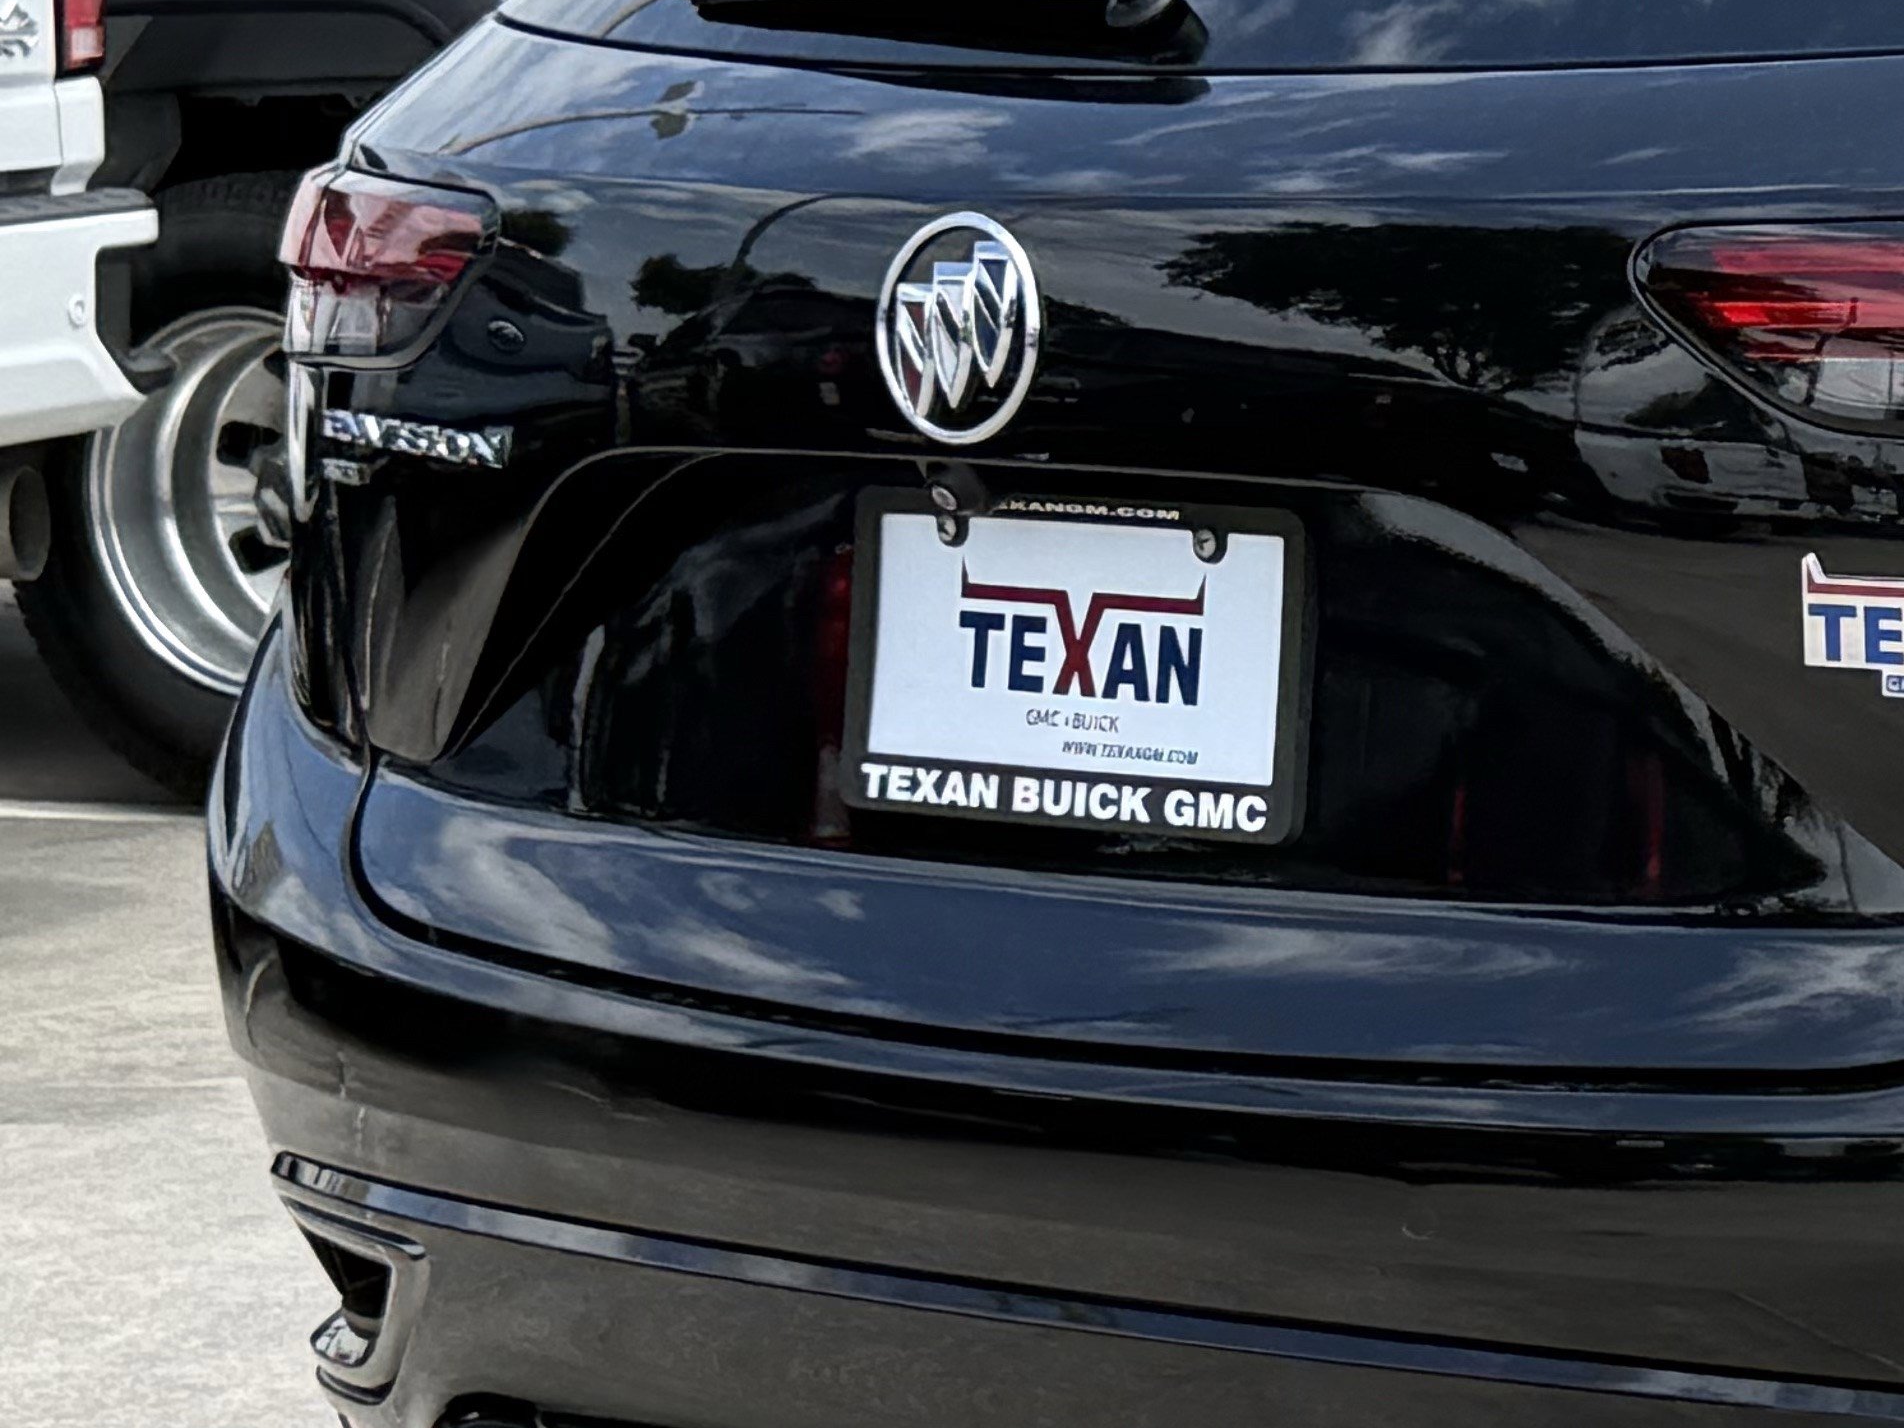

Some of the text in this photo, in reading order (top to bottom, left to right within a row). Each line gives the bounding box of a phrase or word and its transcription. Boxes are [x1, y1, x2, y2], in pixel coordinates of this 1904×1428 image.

[959, 591, 1203, 706] TEXAN
[1072, 712, 1119, 733] BUICK
[860, 763, 1267, 833] TEXAN BUICK GMC
